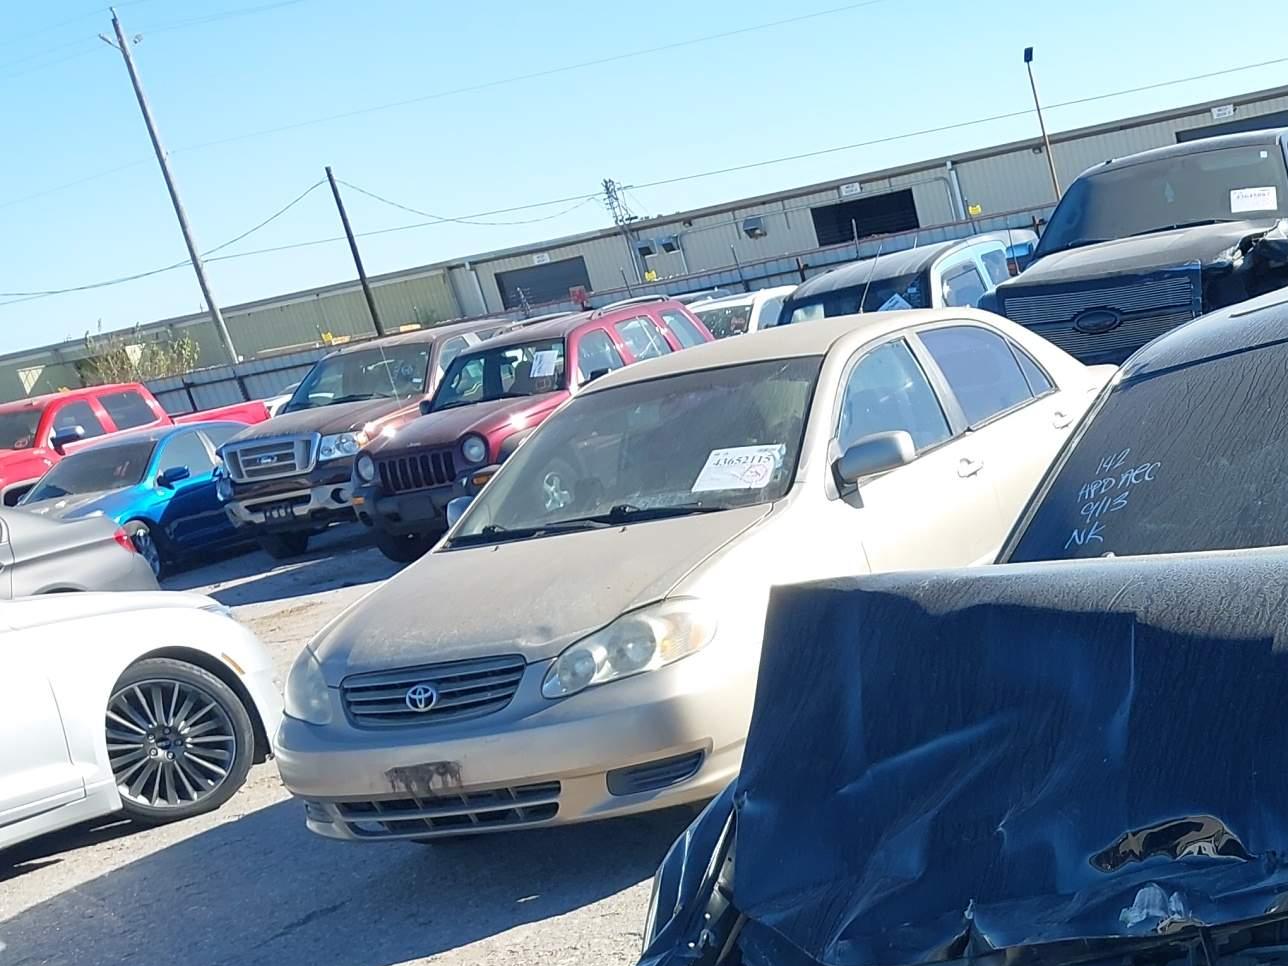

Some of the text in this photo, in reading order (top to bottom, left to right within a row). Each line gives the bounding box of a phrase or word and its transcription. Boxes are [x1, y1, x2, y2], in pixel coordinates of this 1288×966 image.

[713, 455, 771, 467] 43652115
[1095, 448, 1131, 475] 142
[1064, 521, 1106, 549] NK
